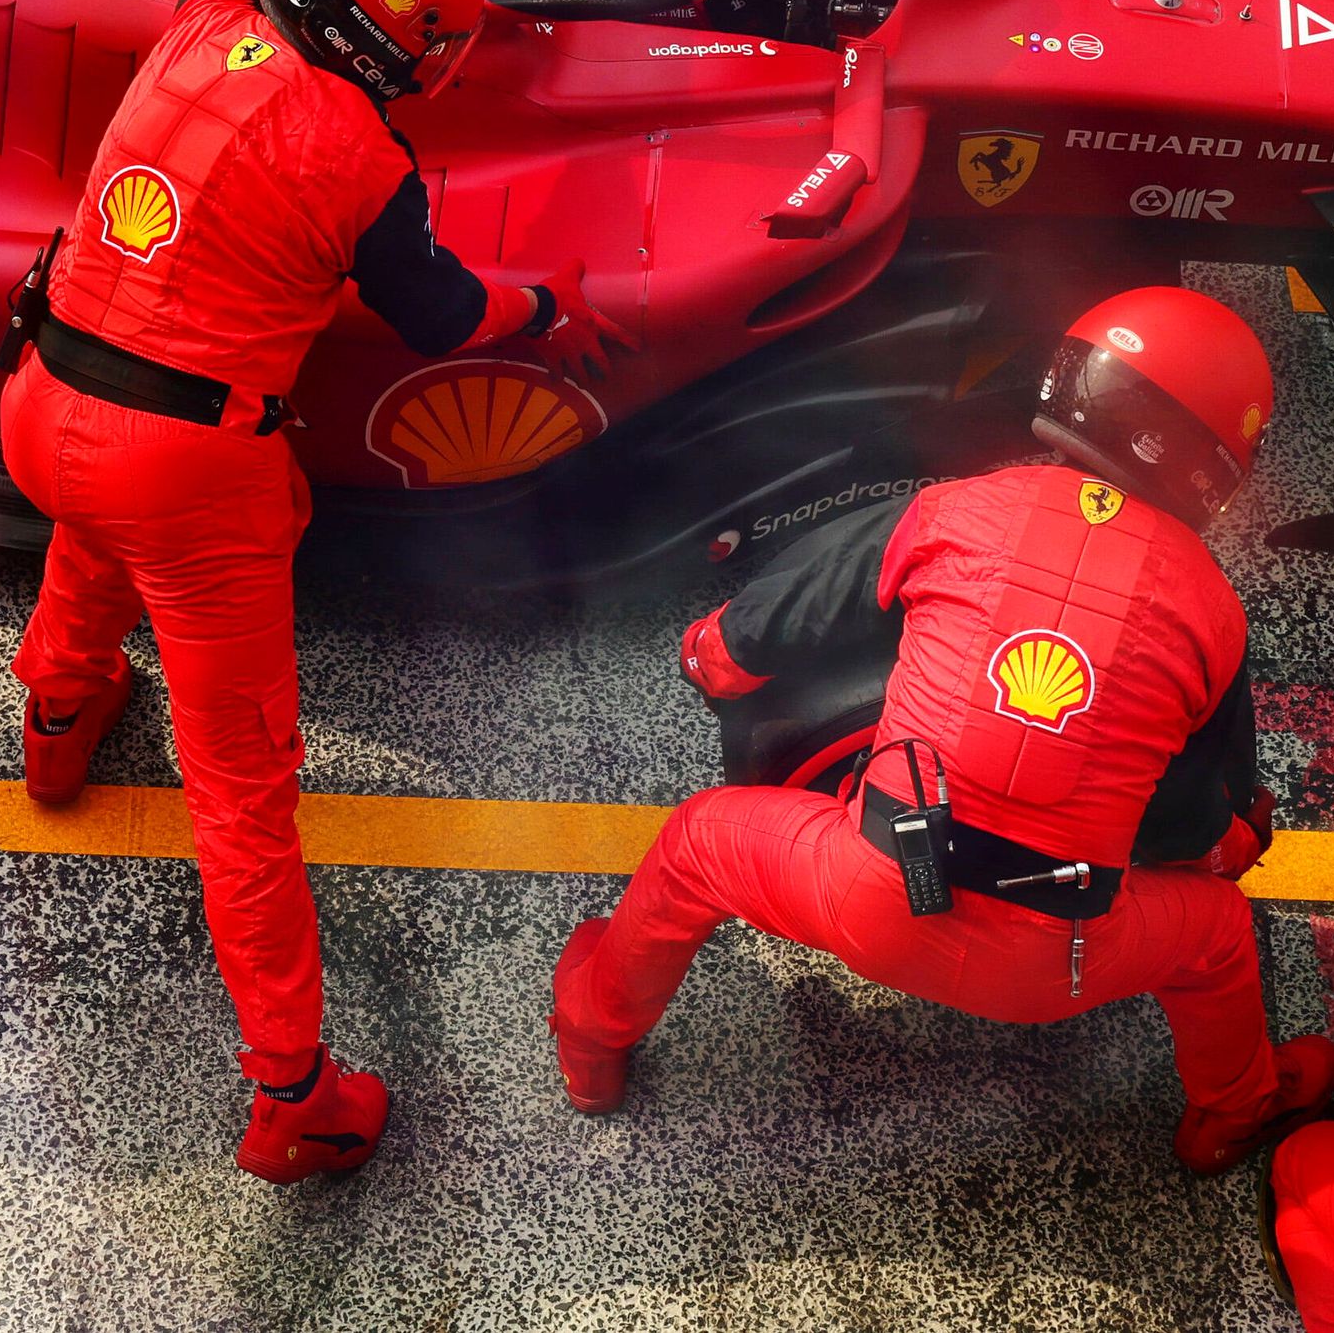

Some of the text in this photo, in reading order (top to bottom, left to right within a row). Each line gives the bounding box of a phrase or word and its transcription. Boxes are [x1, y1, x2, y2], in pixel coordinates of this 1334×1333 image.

[349, 4, 387, 47] RICHARD
[384, 41, 410, 65] MILLE
[648, 41, 755, 58] Snapdragon
[1065, 128, 1244, 160] RICHARD
[787, 168, 833, 209] VELAS
[1112, 330, 1139, 349] BELL
